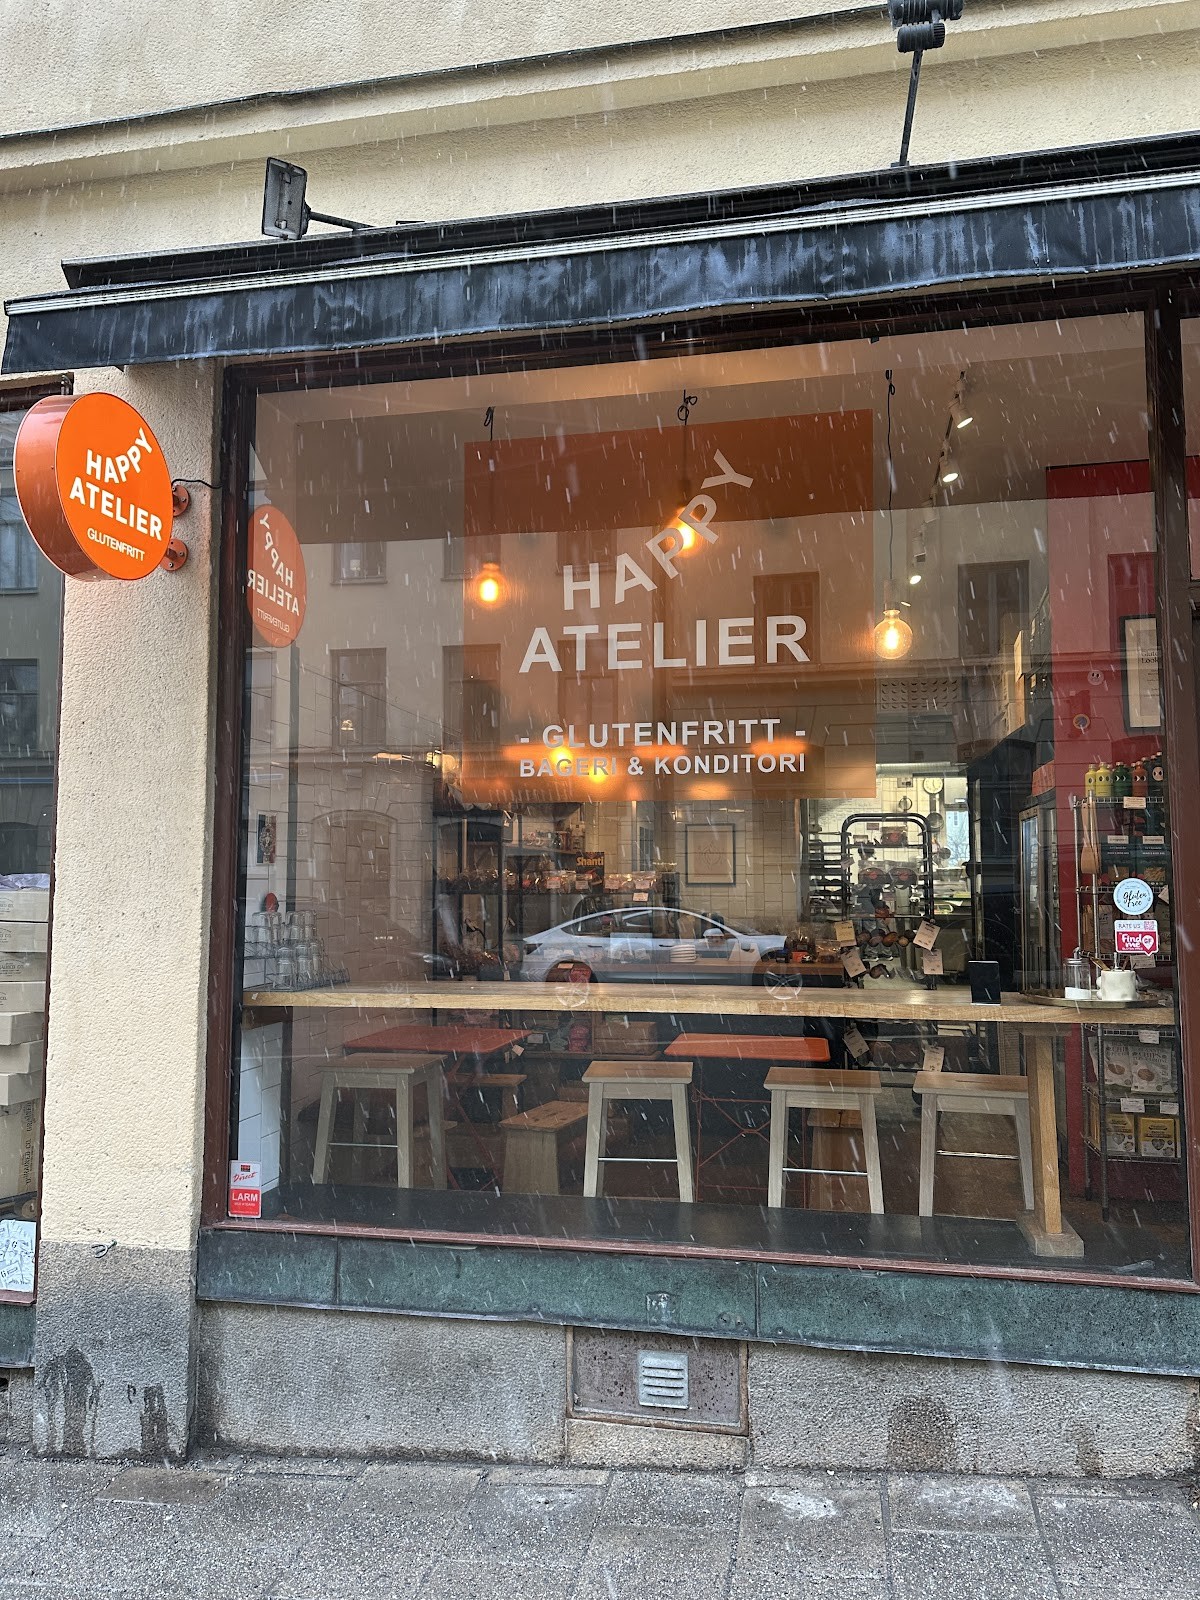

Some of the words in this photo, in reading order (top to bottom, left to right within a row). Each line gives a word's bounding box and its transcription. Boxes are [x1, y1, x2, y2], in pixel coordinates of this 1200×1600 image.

[86, 427, 153, 483] HAPPY
[69, 476, 163, 541] ATELIER
[563, 449, 754, 610] HAPPY
[87, 527, 145, 562] GLUTENFRITT
[518, 615, 811, 673] ATELIER
[542, 718, 781, 748] GLUTENFRITT
[519, 757, 617, 778] BAGERI
[627, 758, 645, 776] &
[654, 753, 806, 775] KONDITORI
[232, 1192, 258, 1202] LARM
